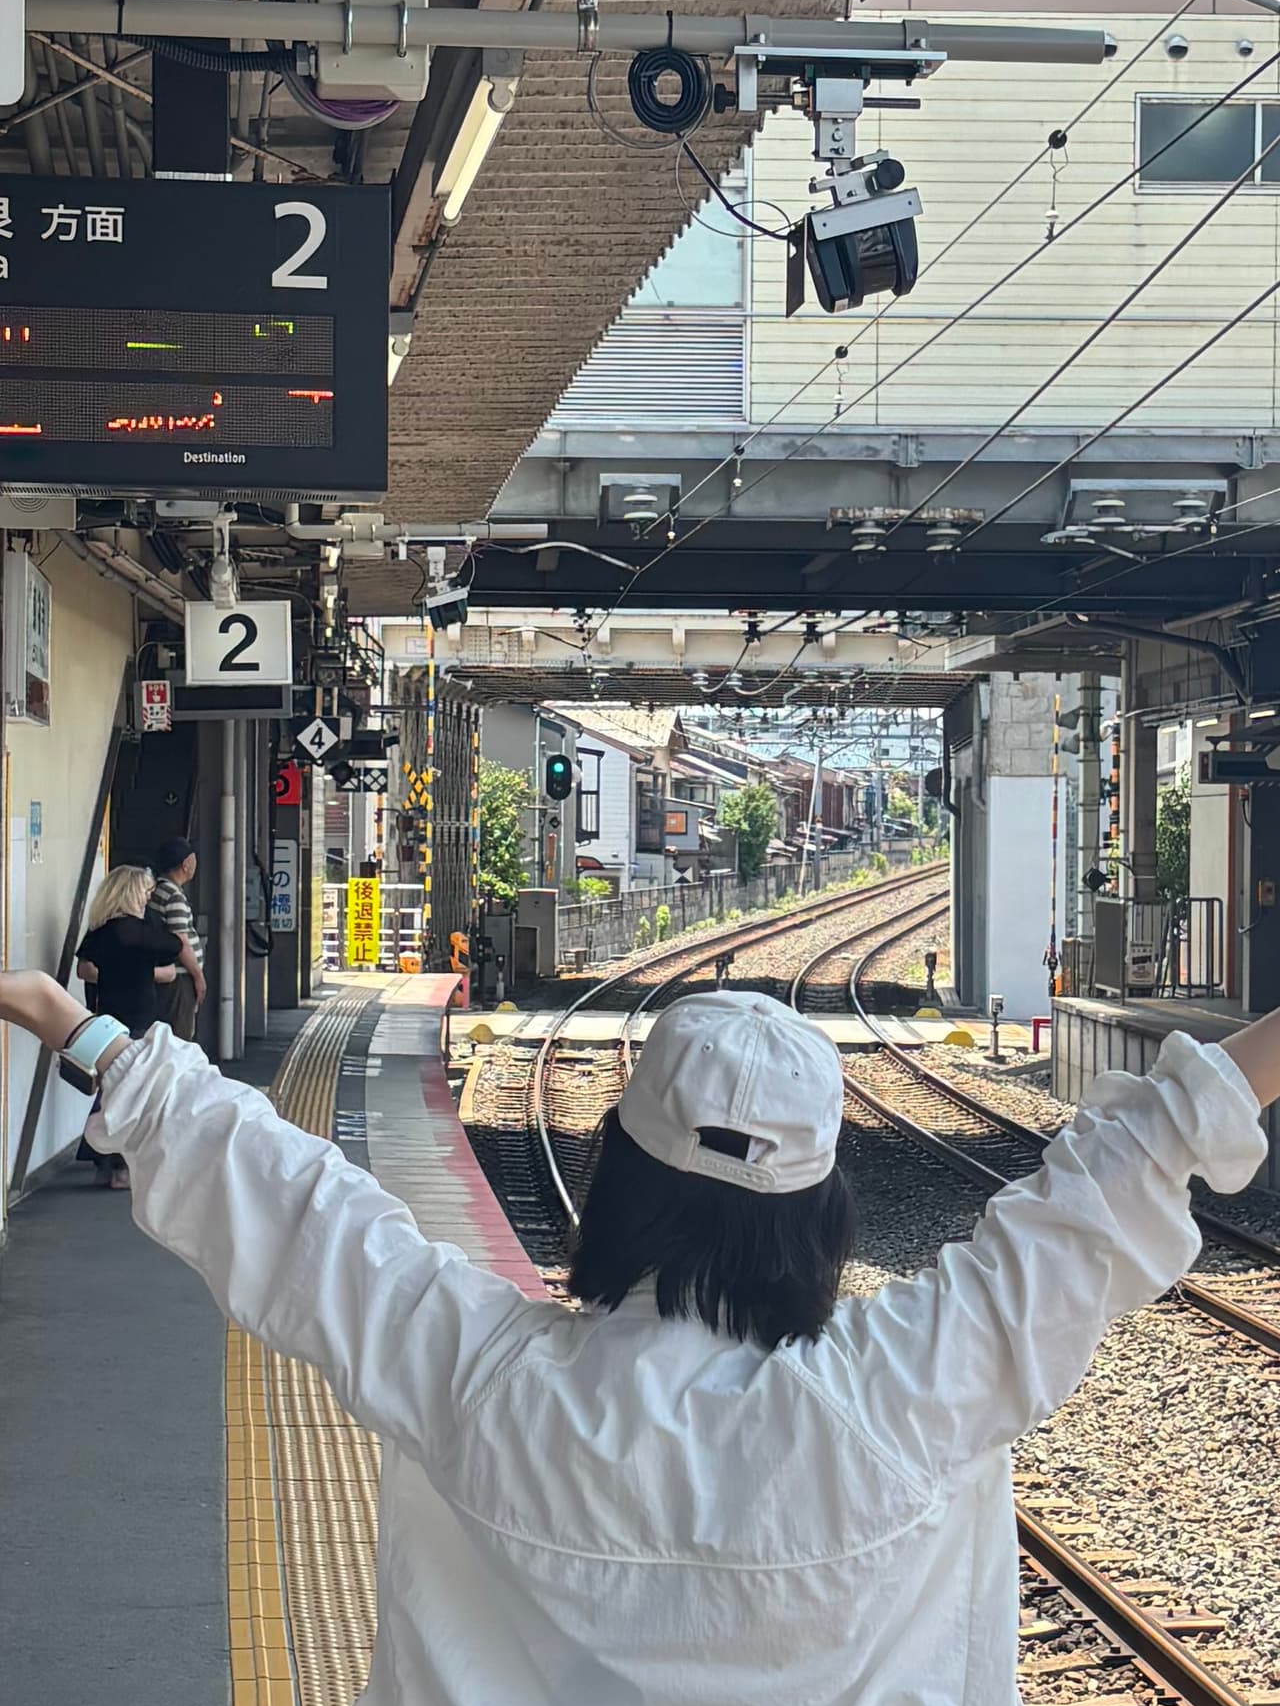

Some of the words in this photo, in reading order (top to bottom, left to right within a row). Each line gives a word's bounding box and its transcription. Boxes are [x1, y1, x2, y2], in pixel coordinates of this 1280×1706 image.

[41, 205, 126, 244] 方面
[270, 201, 330, 289] 2
[184, 451, 247, 466] Destination
[218, 612, 260, 673] 2
[310, 727, 325, 751] 4
[354, 881, 374, 963] 後退禁止
